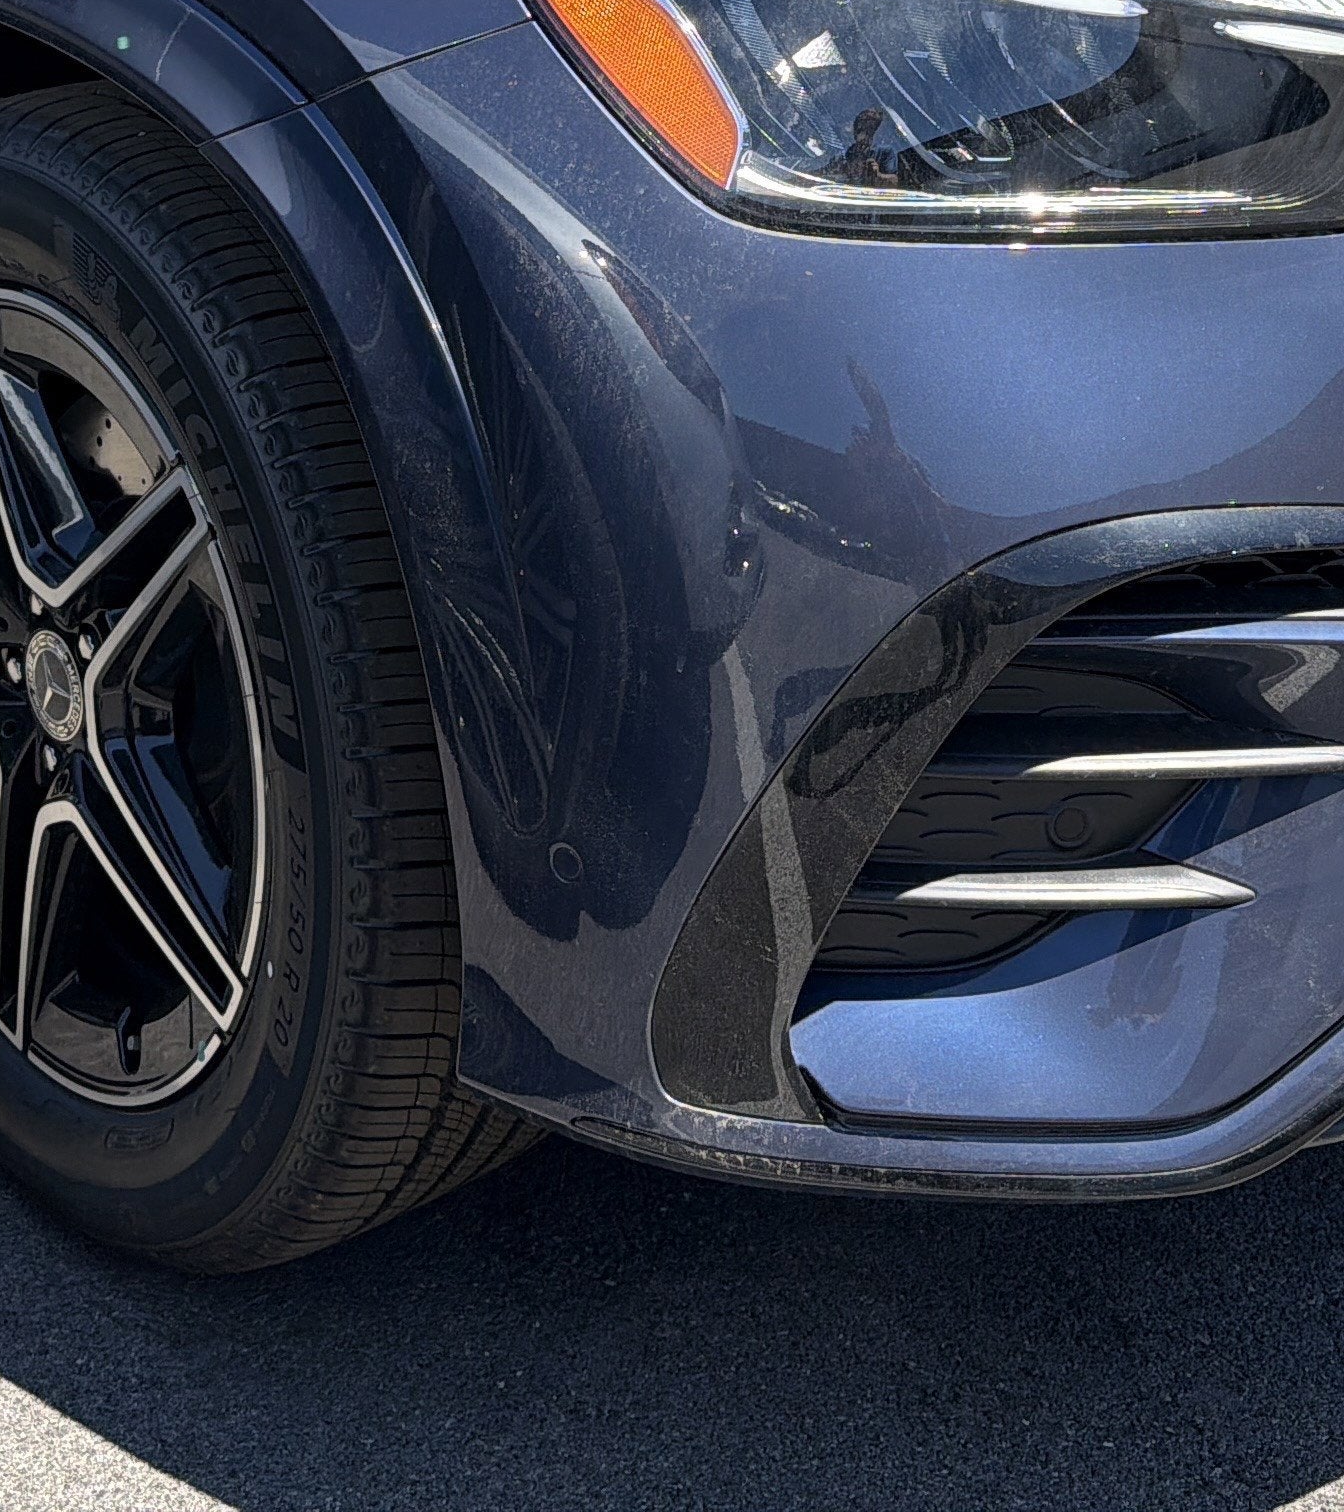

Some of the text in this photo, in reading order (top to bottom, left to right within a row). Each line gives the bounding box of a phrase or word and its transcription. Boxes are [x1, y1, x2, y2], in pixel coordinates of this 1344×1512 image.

[126, 310, 301, 740] MICHELIN
[284, 807, 308, 954] 275/50
[273, 999, 294, 1048] 20
